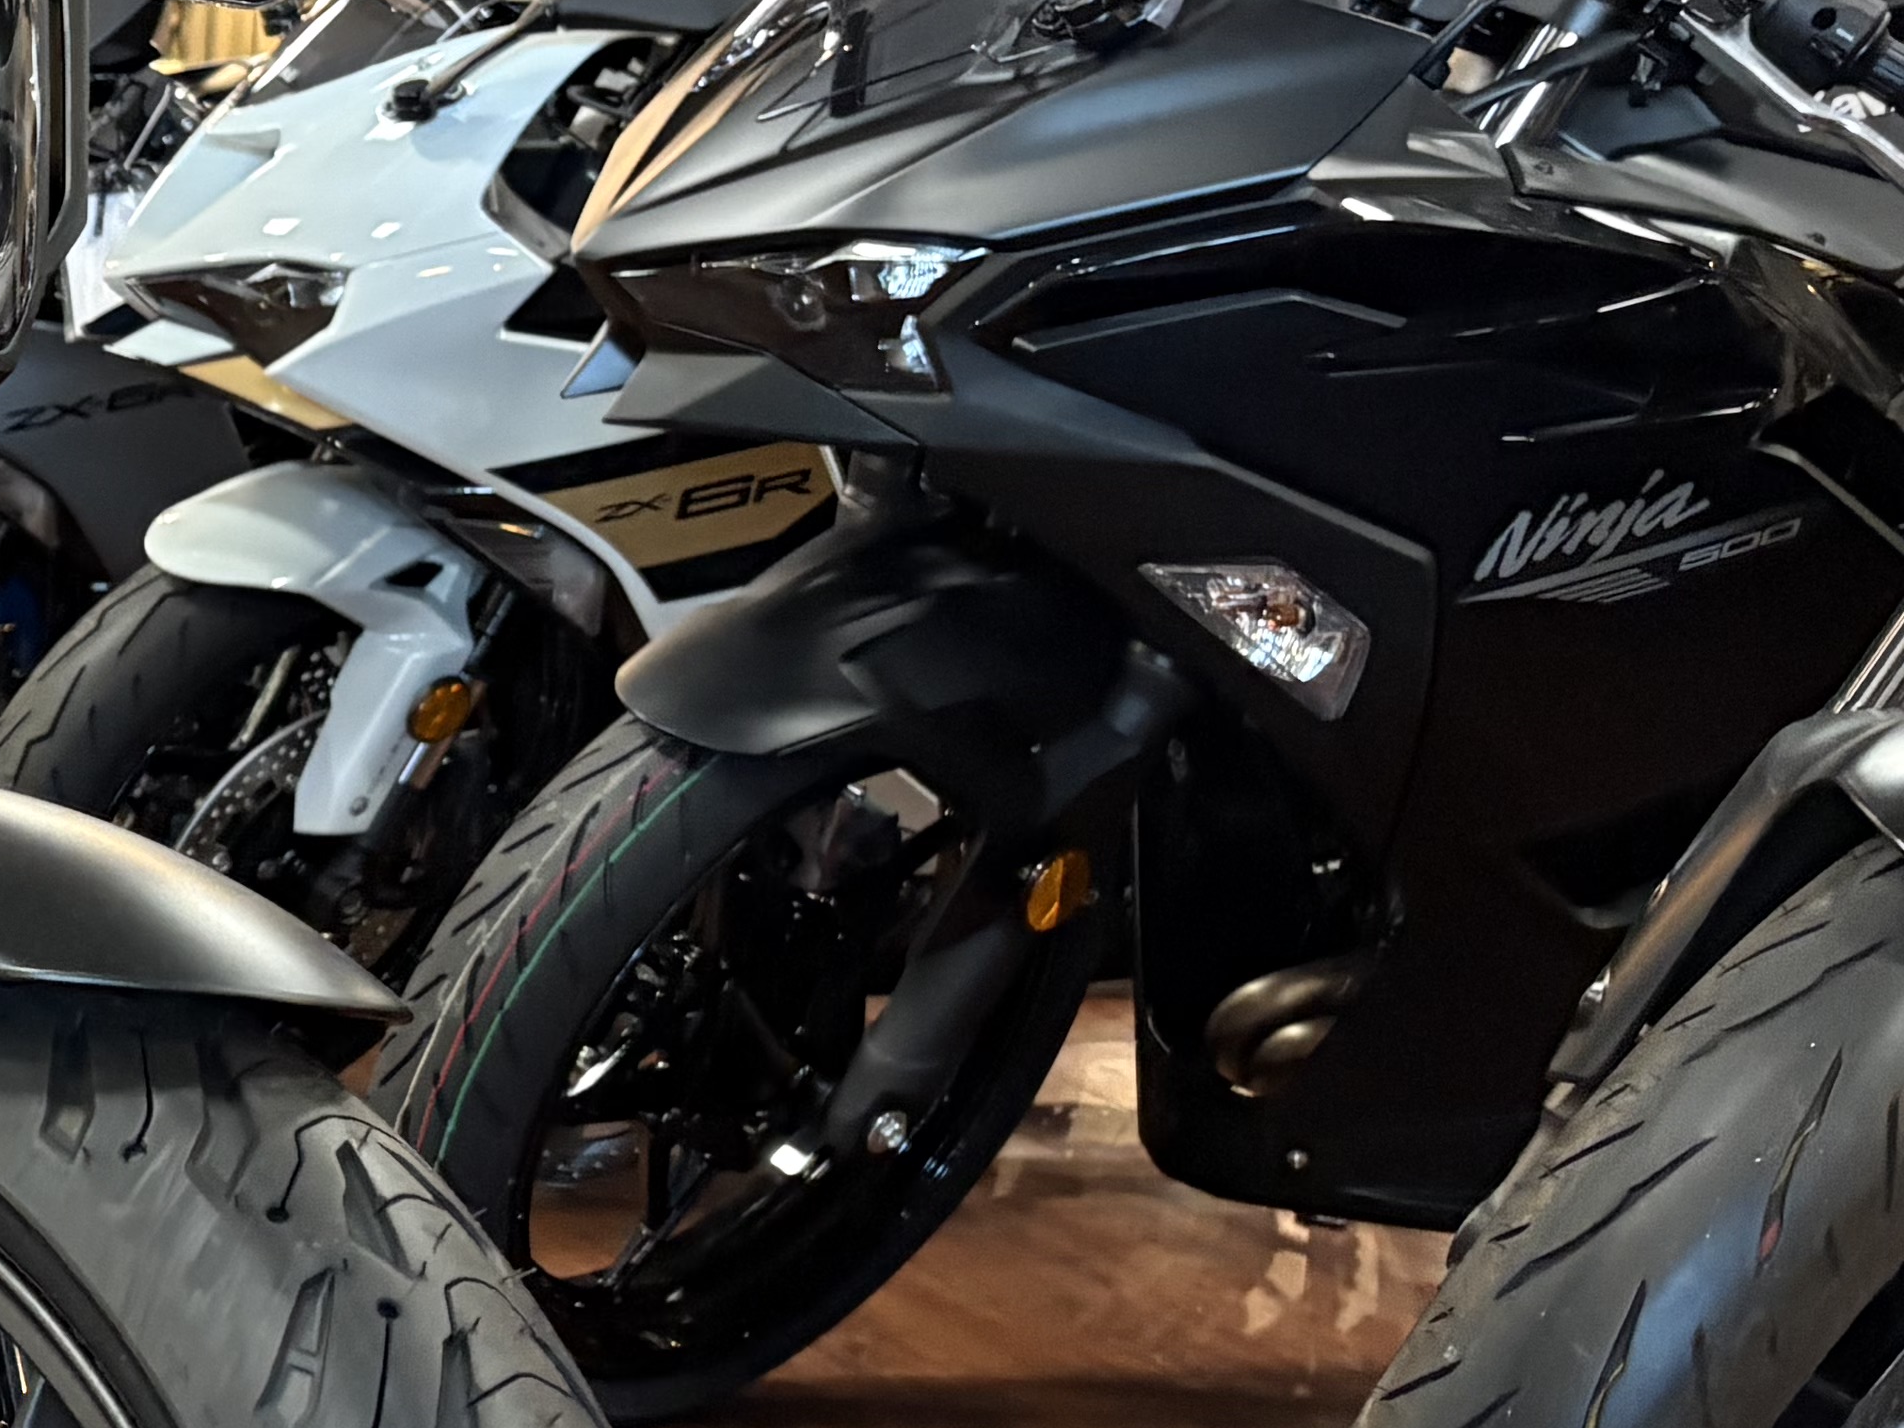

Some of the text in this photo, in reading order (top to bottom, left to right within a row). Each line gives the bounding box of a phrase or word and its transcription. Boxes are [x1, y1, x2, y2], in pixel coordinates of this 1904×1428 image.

[595, 466, 813, 524] ZX-6R
[1474, 468, 1800, 582] Ninja 500
